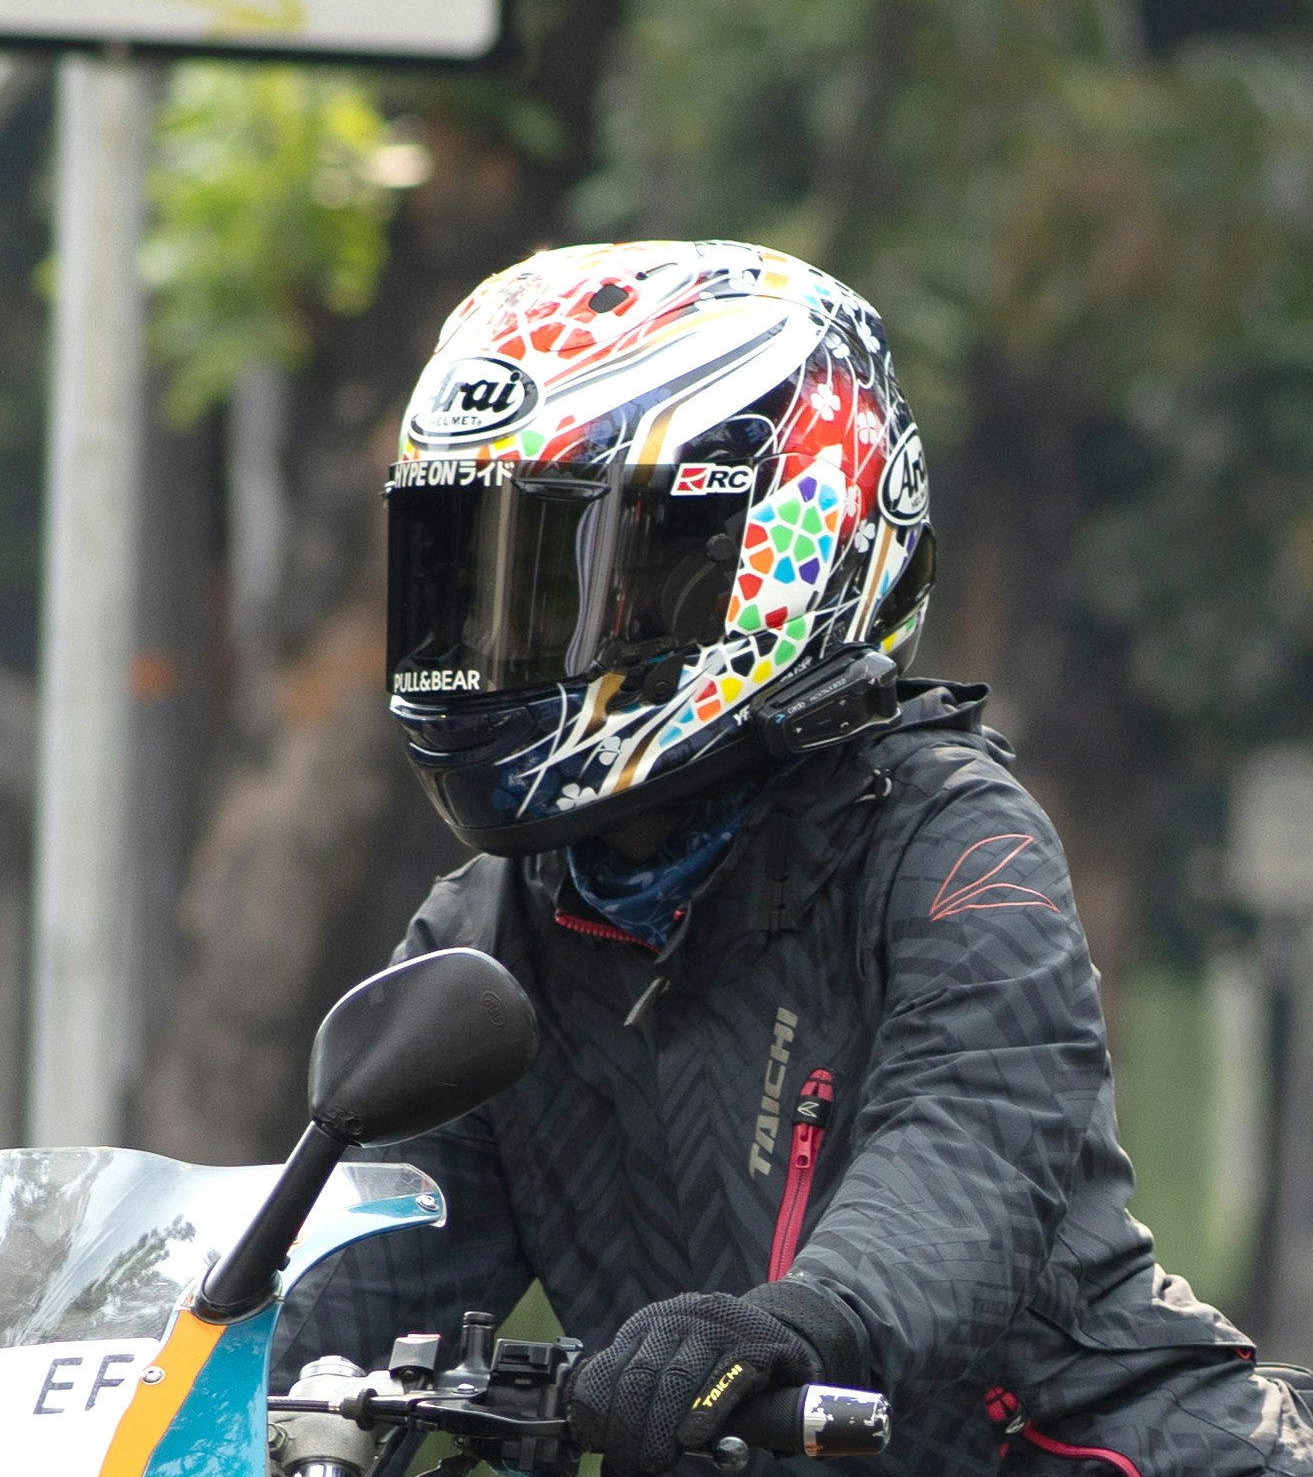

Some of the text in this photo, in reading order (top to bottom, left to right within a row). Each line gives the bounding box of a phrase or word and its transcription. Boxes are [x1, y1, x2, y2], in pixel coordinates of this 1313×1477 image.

[428, 366, 521, 413] Arai
[394, 462, 427, 489] HYPE
[428, 461, 457, 487] ON
[393, 670, 481, 693] PULL&BEAR
[749, 1006, 799, 1181] TAICHI
[32, 1354, 136, 1415] EF
[702, 1364, 744, 1408] TAICHI
